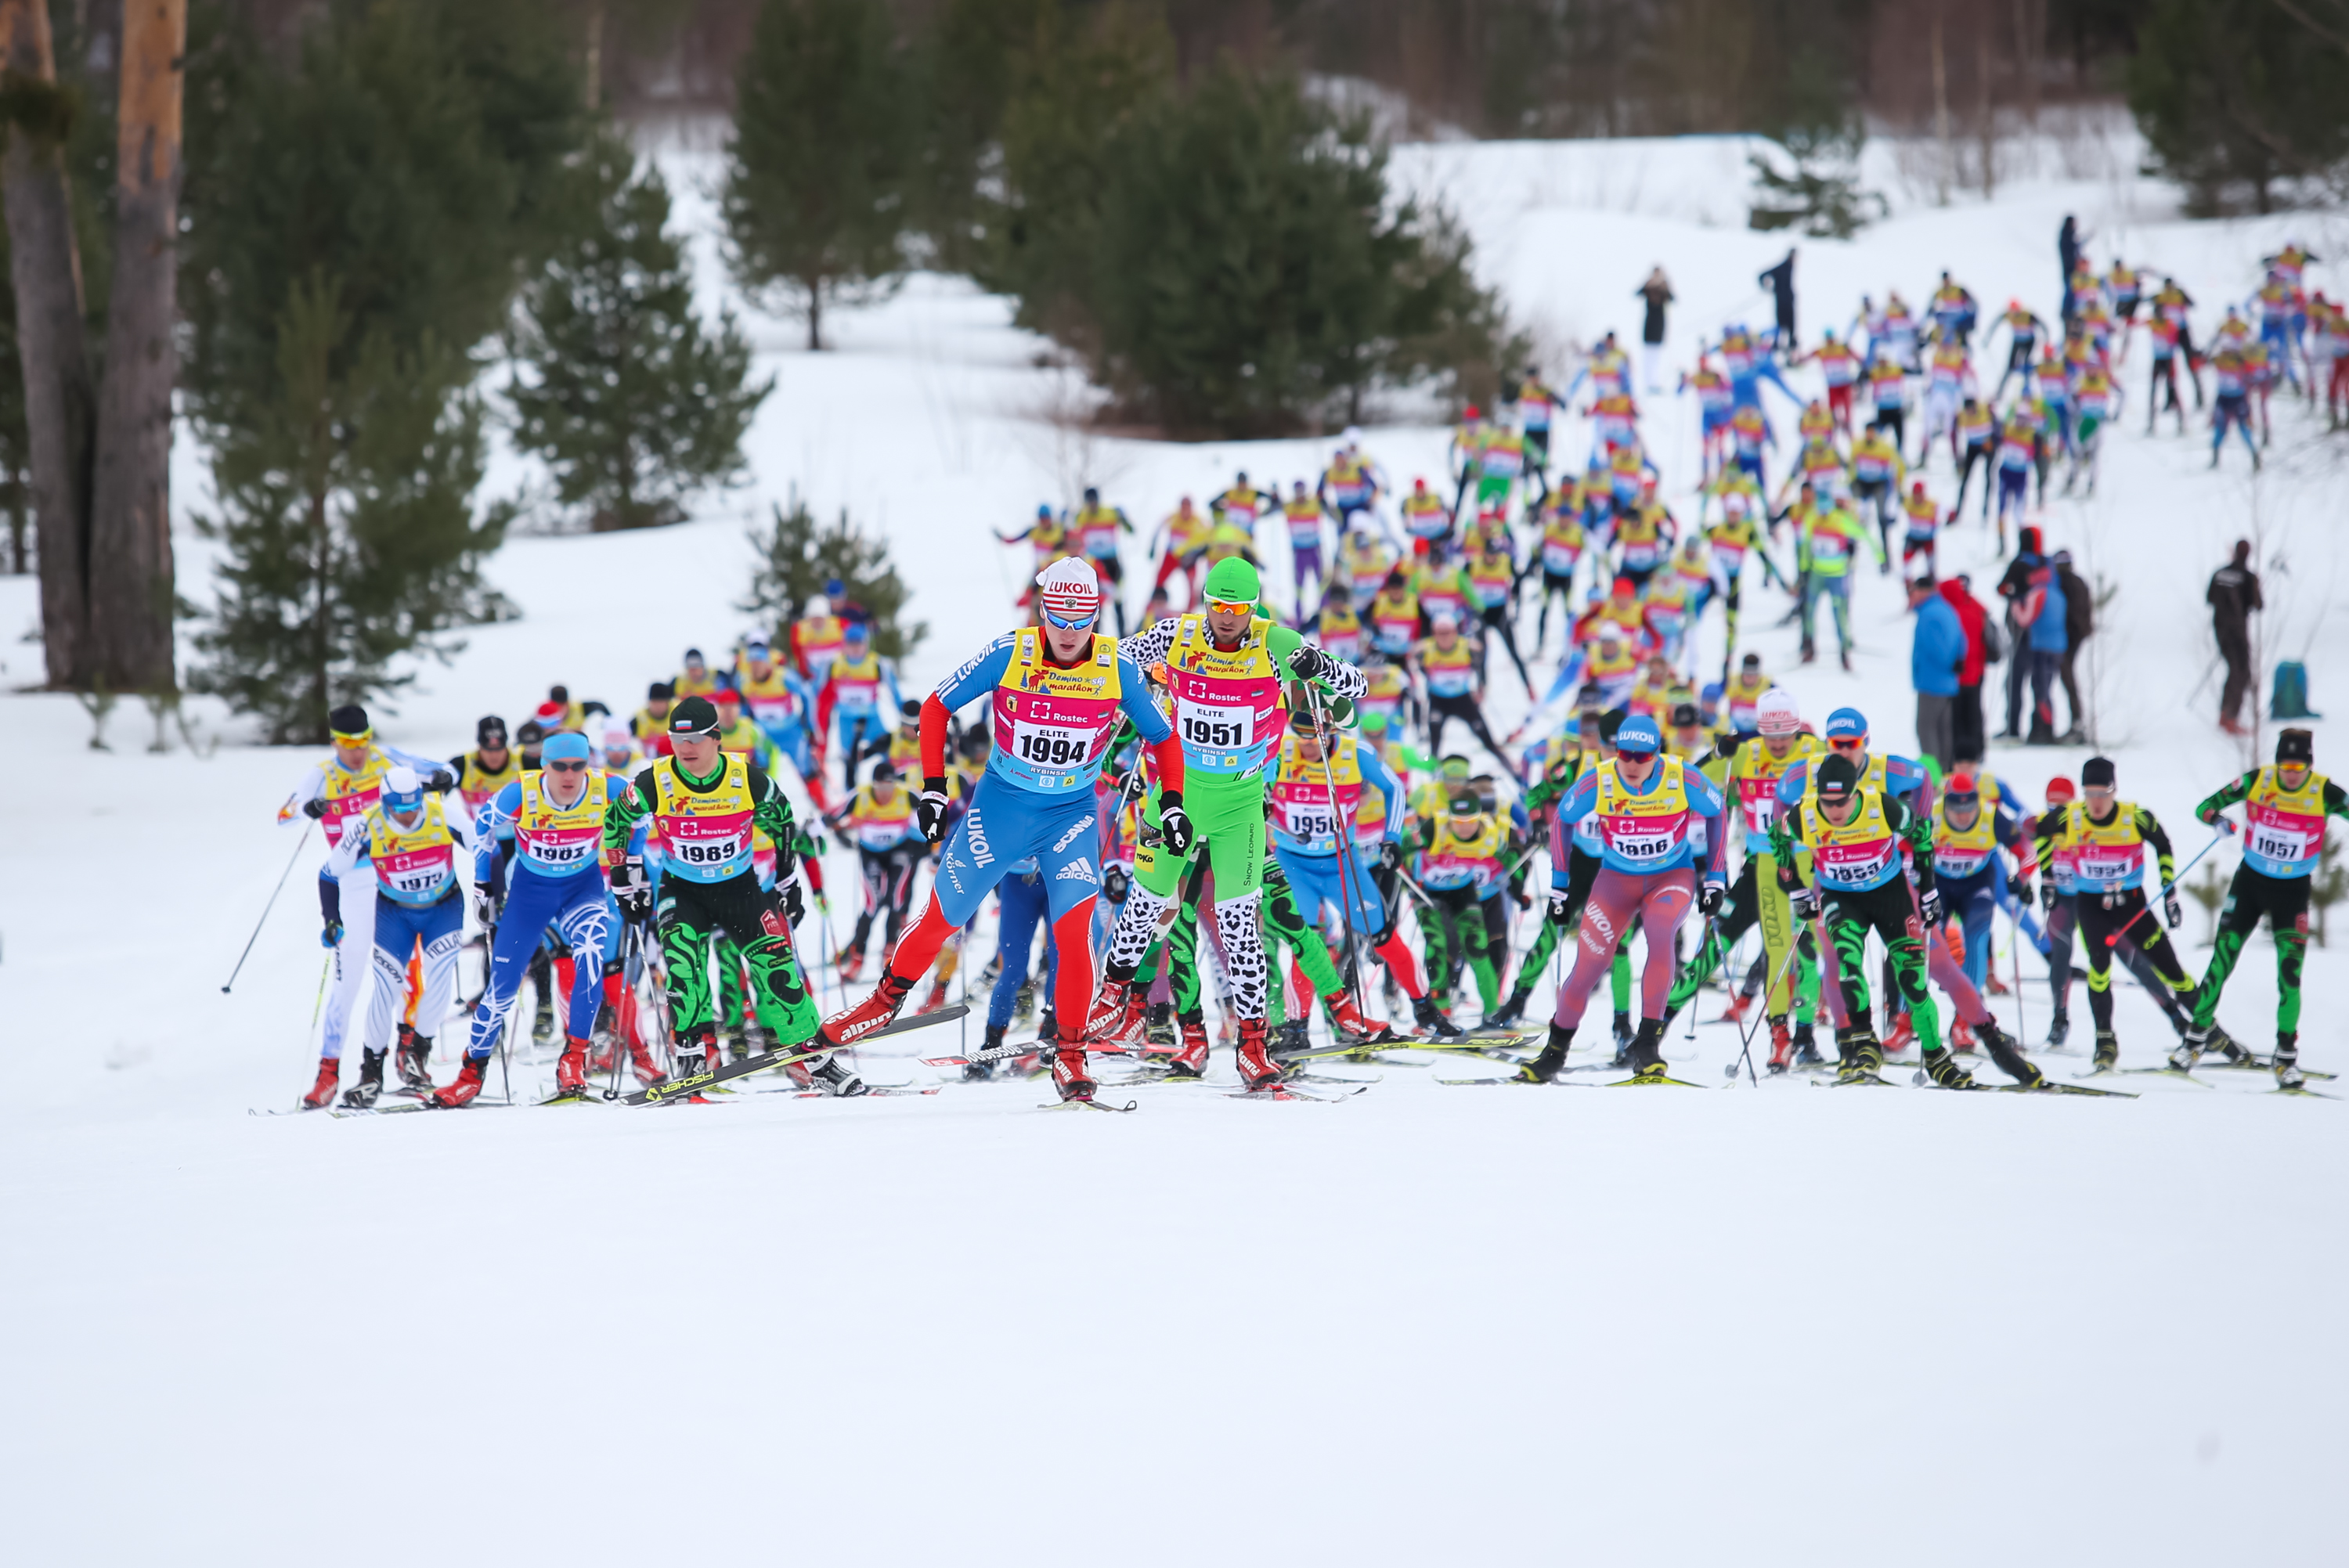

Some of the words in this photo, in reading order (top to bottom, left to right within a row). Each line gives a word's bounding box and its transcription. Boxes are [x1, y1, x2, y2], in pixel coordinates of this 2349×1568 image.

[1048, 581, 1093, 595] LUKOIL
[955, 640, 998, 683] LUKOIL
[1048, 671, 1083, 683] Demino
[1048, 683, 1093, 693] marathon
[1208, 692, 1242, 701] Rostec
[1052, 712, 1088, 723] Rostec
[1196, 708, 1225, 718] ELITE
[1039, 729, 1070, 738] ELITE
[1182, 717, 1243, 746] 1951
[1618, 730, 1656, 745] LUKOIL
[1019, 734, 1087, 766] 1994
[1192, 746, 1227, 756] RYBINSK
[1029, 766, 1068, 777] RYBINSK
[700, 827, 733, 836] Rostec
[966, 807, 996, 870] LUKOIL
[1052, 814, 1095, 854] SCANIA
[679, 841, 736, 863] 1989
[945, 852, 965, 896] Körner
[1055, 869, 1098, 886] adidas
[1243, 862, 1253, 886] SNOW
[962, 1044, 1024, 1063] ROSSIGNOL
[660, 1069, 715, 1094] FISCHER
